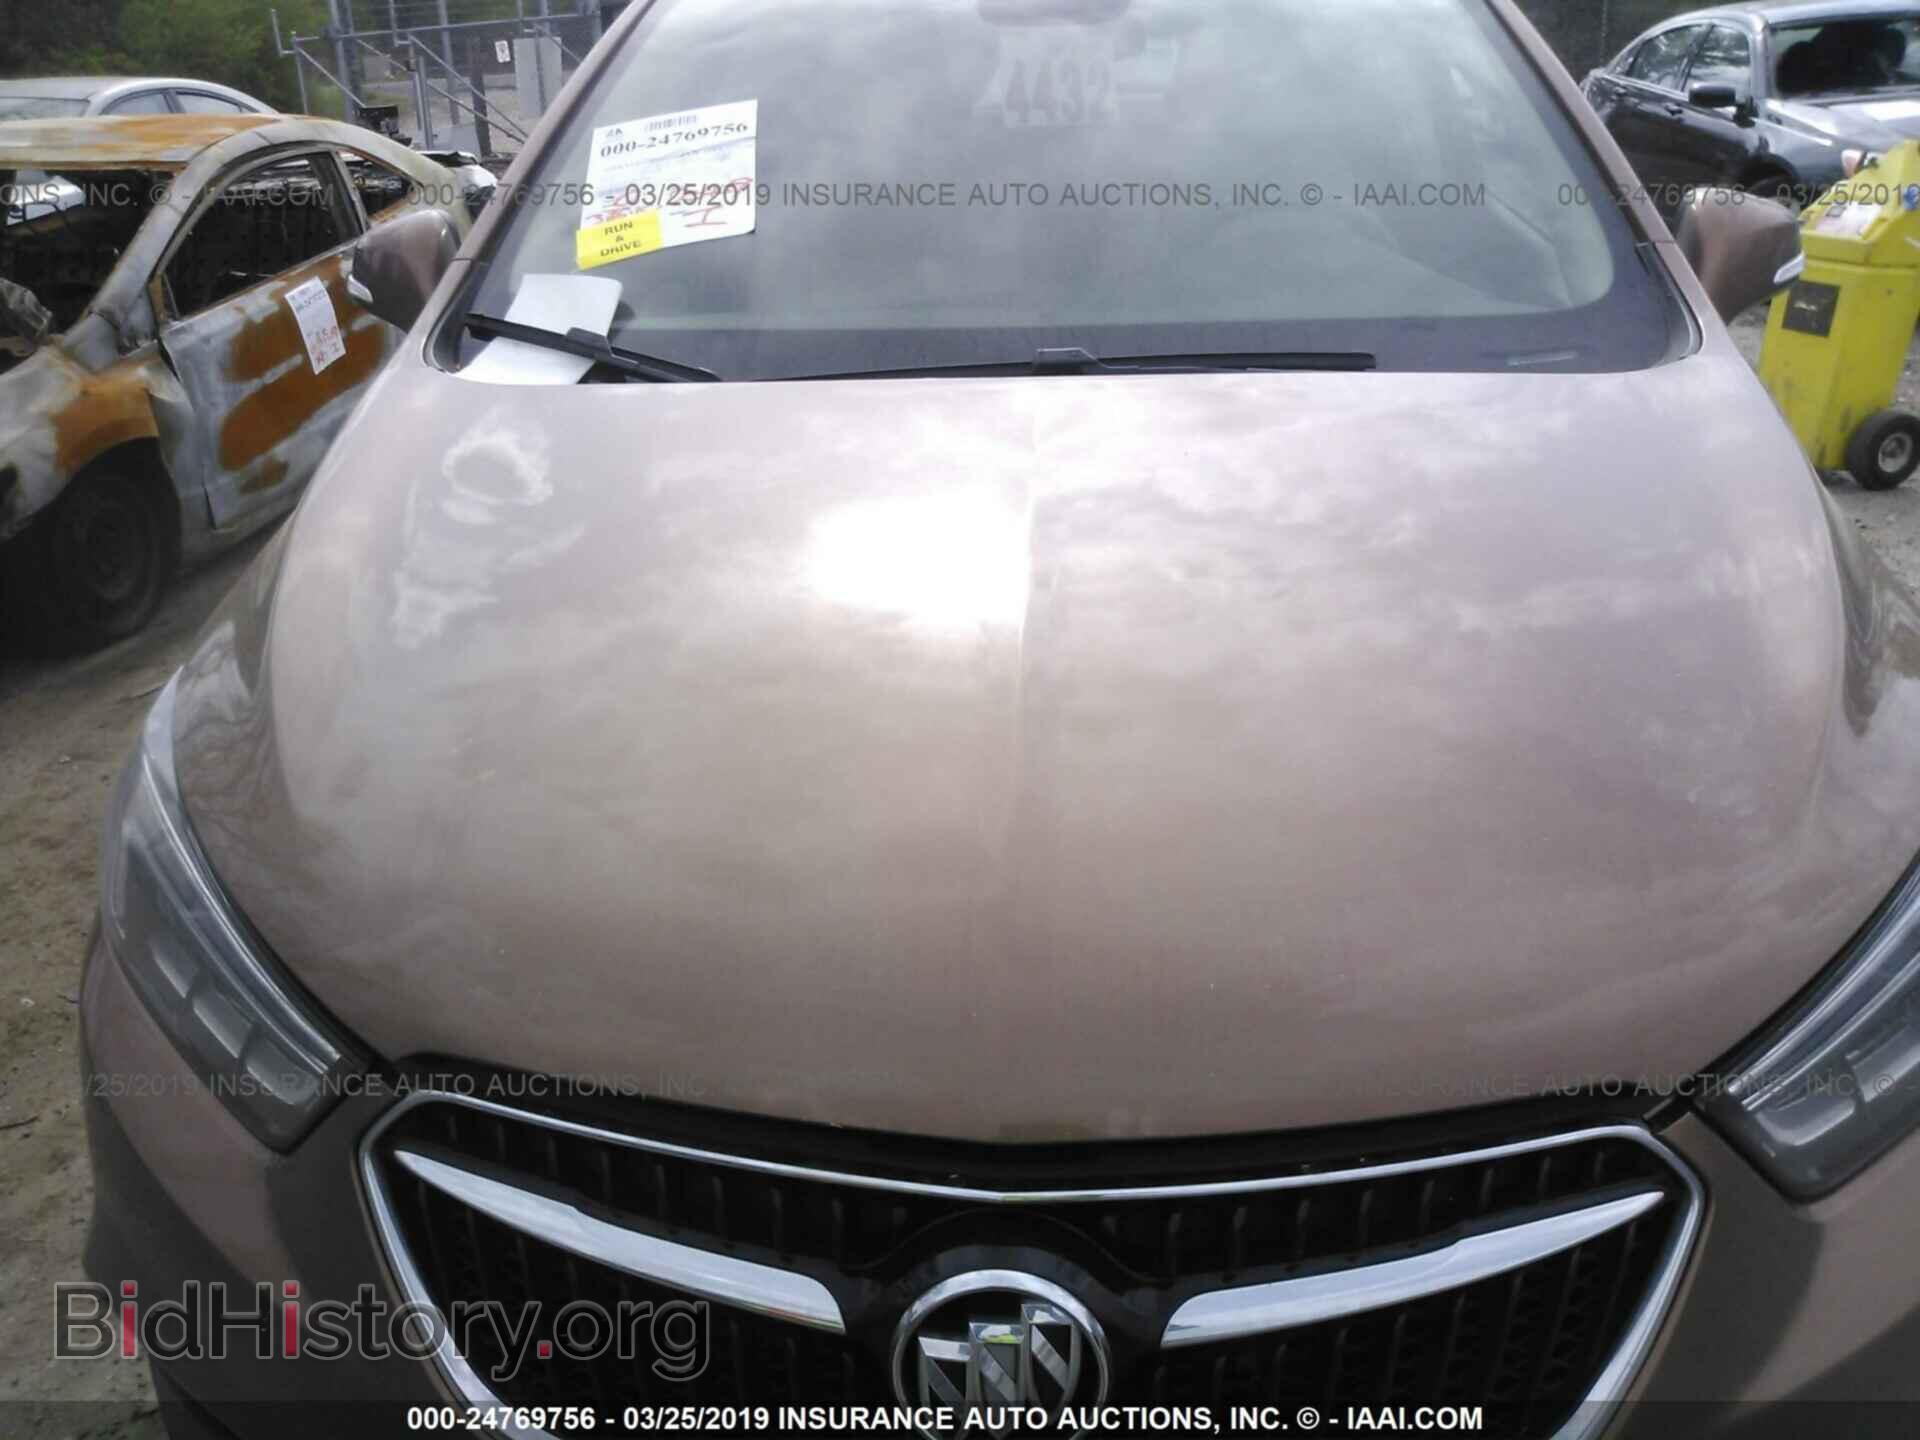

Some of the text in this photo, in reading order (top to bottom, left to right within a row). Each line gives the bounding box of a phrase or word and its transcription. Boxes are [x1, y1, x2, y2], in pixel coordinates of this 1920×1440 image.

[600, 122, 749, 158] 000-24769756
[603, 221, 634, 236] RUN
[600, 240, 642, 258] DRIVE
